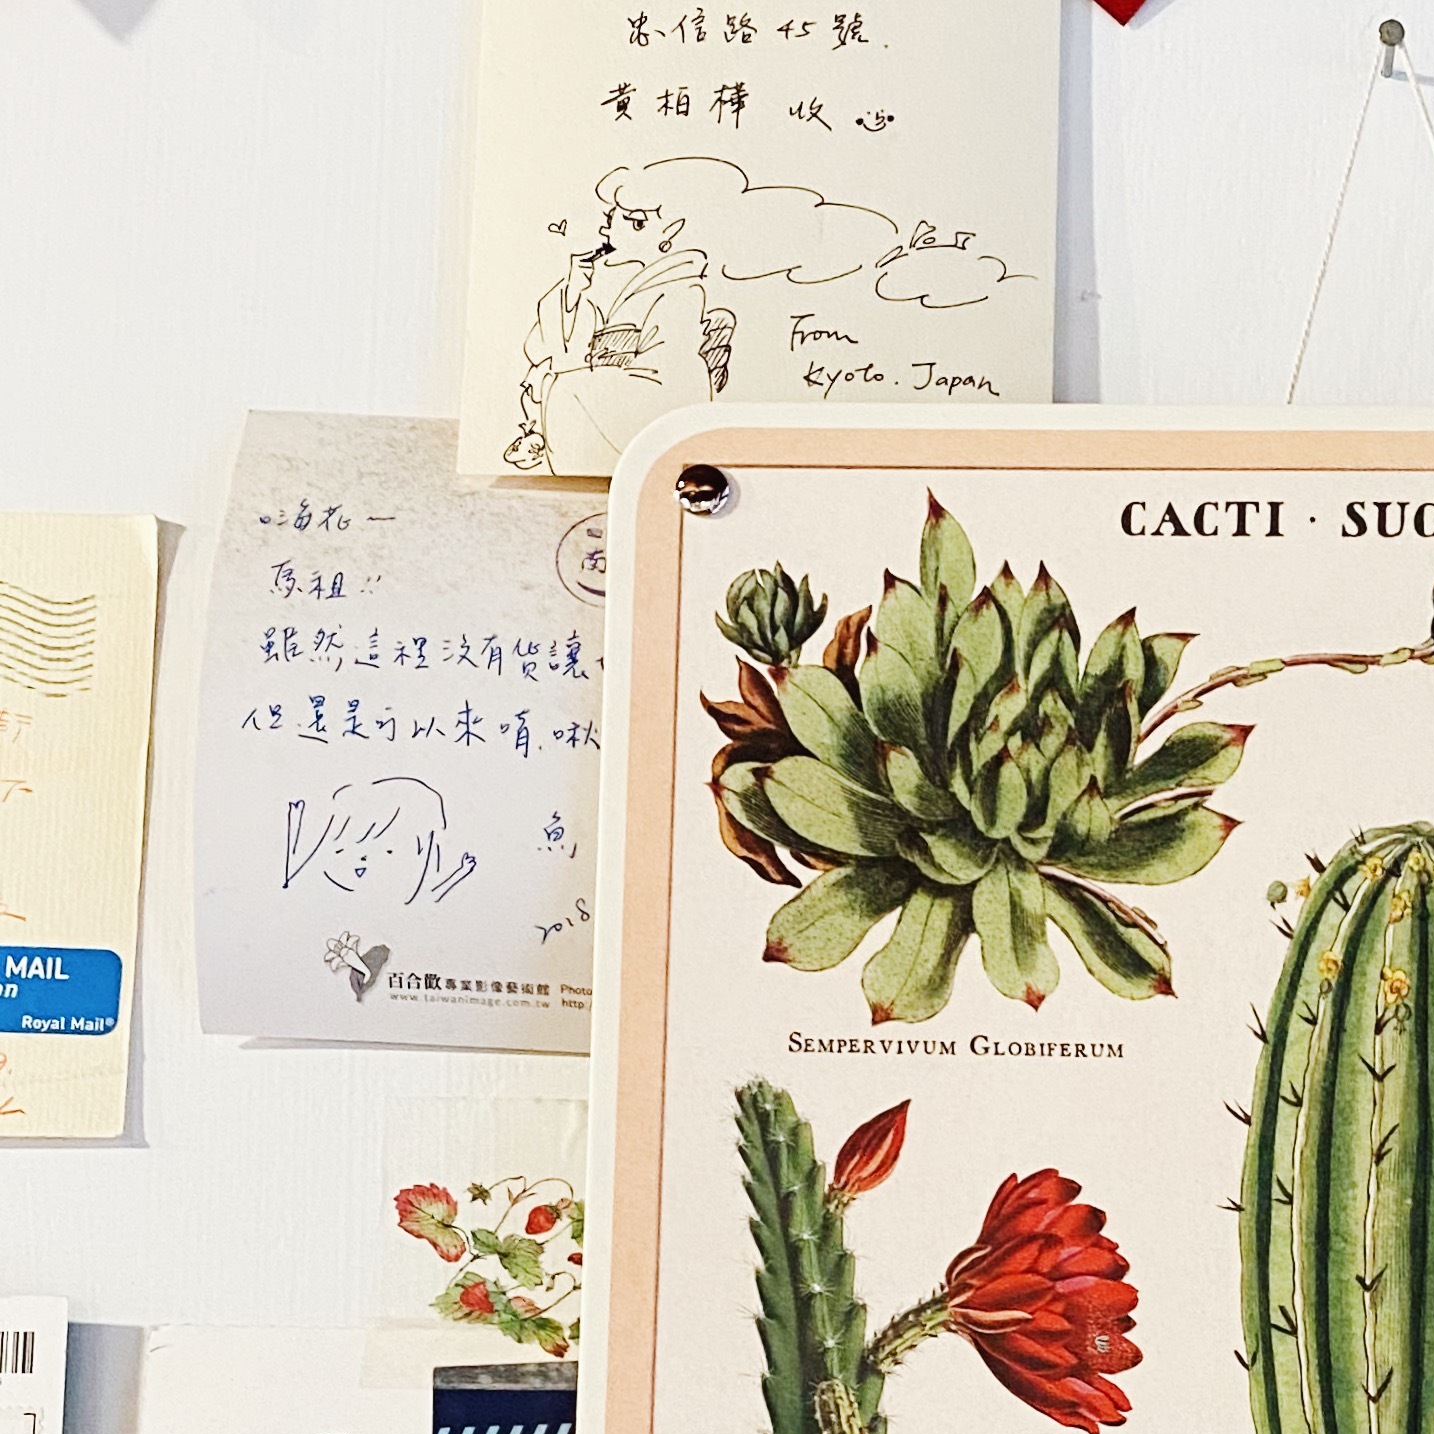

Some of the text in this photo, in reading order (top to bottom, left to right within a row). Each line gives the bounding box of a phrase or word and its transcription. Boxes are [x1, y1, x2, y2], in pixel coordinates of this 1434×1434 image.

[790, 313, 858, 351] From
[912, 362, 1000, 397] Japan
[1120, 501, 1285, 538] CACTI
[5, 956, 69, 980] MAIL
[22, 1015, 65, 1032] Royal
[788, 1032, 1124, 1058] SEMPERVIVUM GLOBIFERUM
